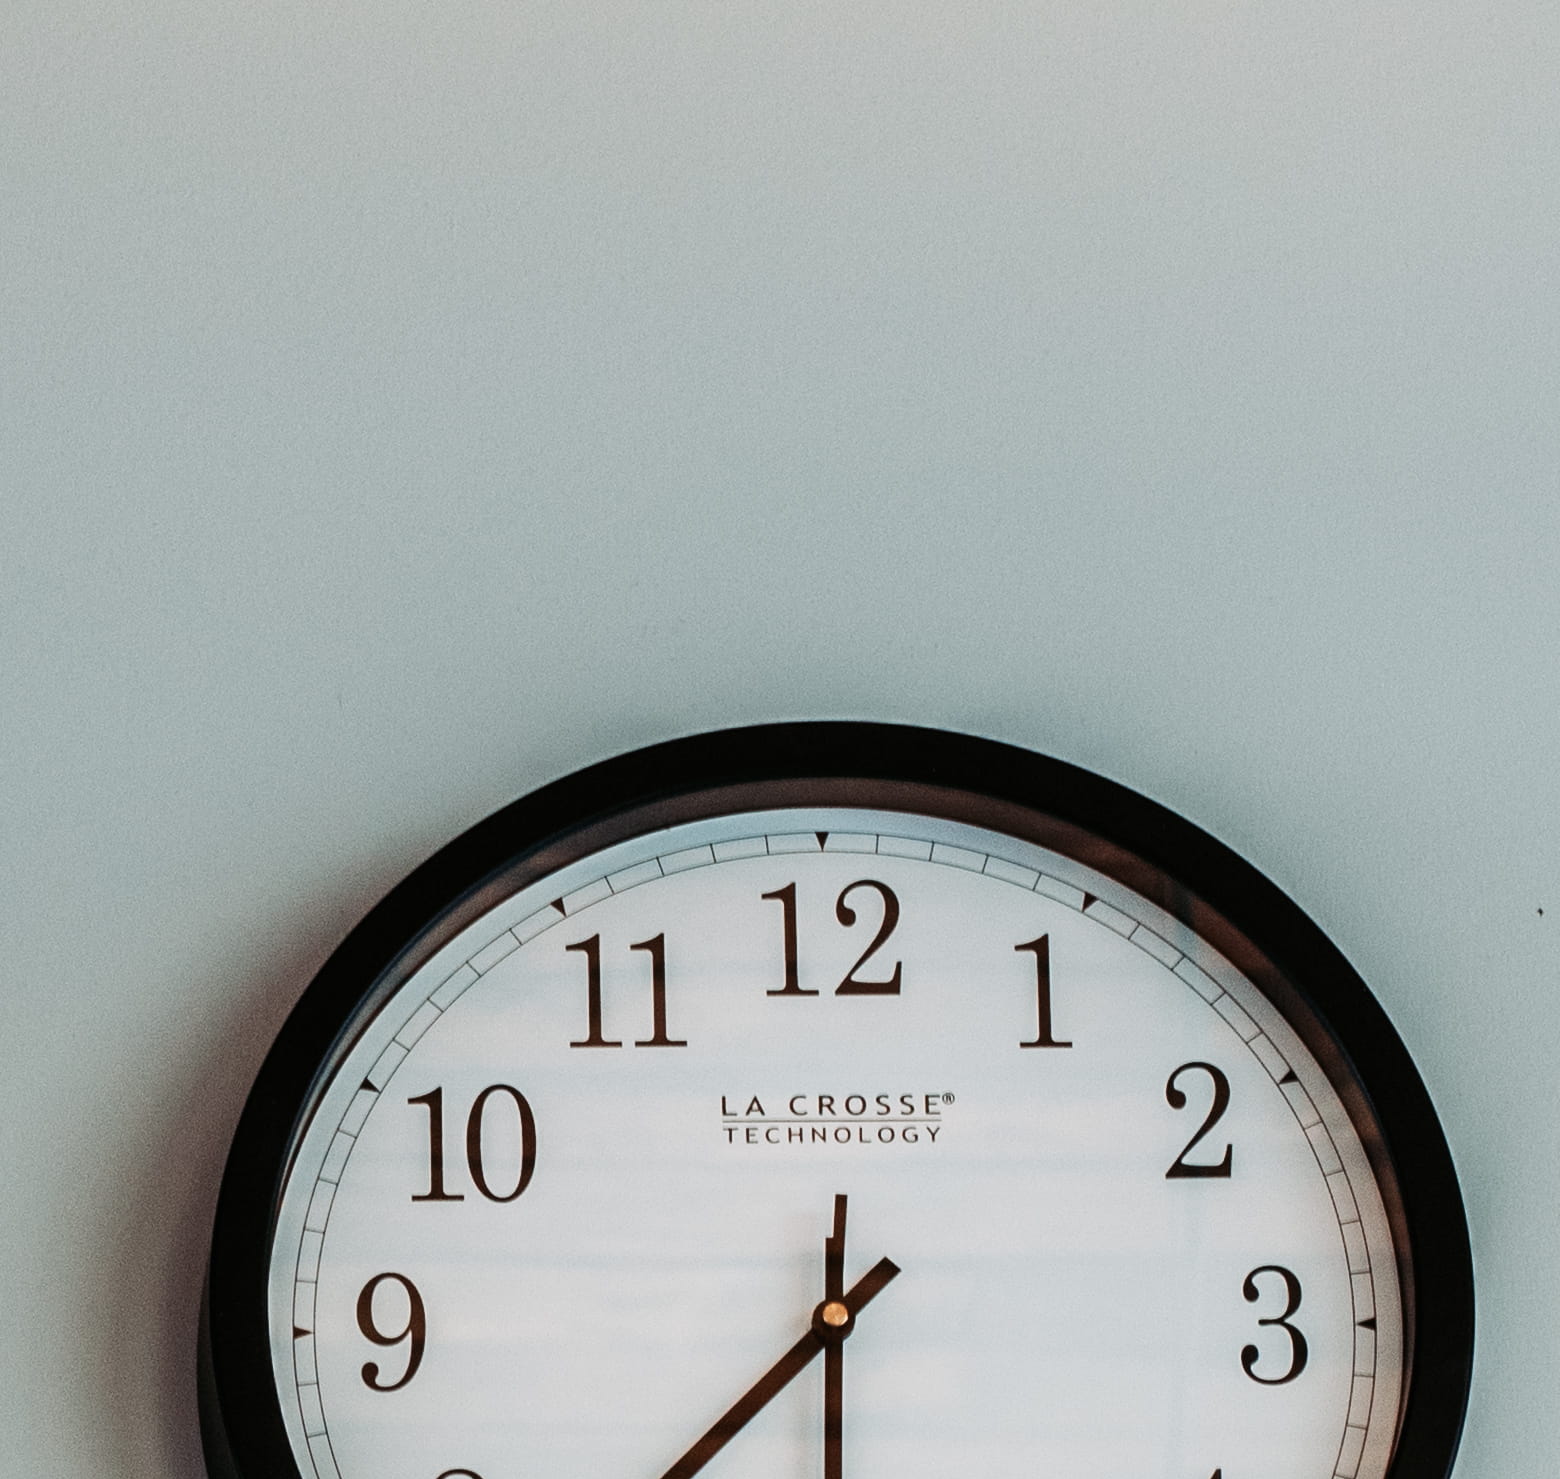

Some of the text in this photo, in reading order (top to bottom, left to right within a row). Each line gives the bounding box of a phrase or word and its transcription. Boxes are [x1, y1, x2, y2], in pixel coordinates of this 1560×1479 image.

[566, 933, 687, 1048] 11
[761, 879, 902, 996] 12
[1015, 933, 1072, 1048] 1
[408, 1084, 536, 1203] 10
[721, 1095, 766, 1116] LA
[723, 1126, 941, 1144] TECHNOLOGY
[1165, 1062, 1232, 1179] 2
[357, 1272, 425, 1392] 9
[1241, 1265, 1308, 1385] 3
